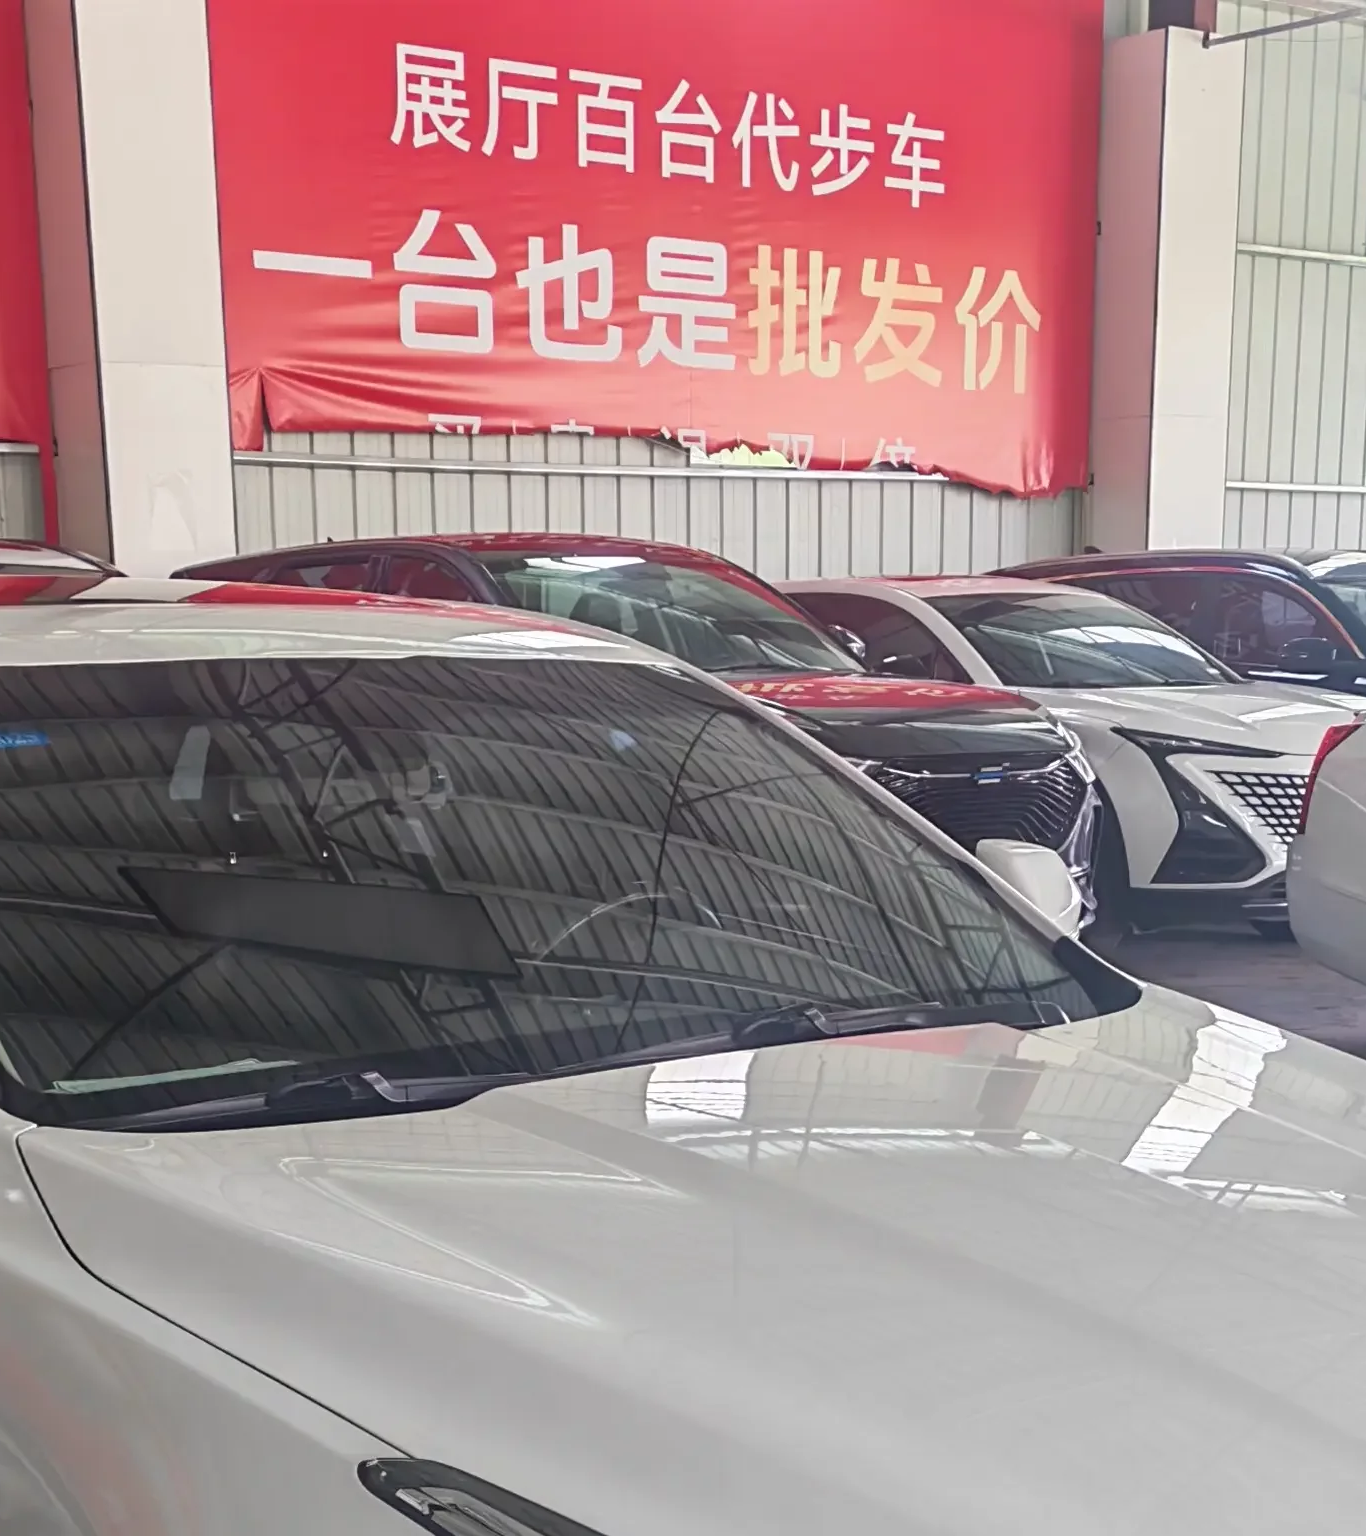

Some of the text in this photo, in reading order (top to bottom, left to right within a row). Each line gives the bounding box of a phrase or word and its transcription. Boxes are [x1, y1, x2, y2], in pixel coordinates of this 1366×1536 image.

[391, 43, 946, 208] 展厅百台代步车
[252, 209, 1042, 393] 一台也是批发价
